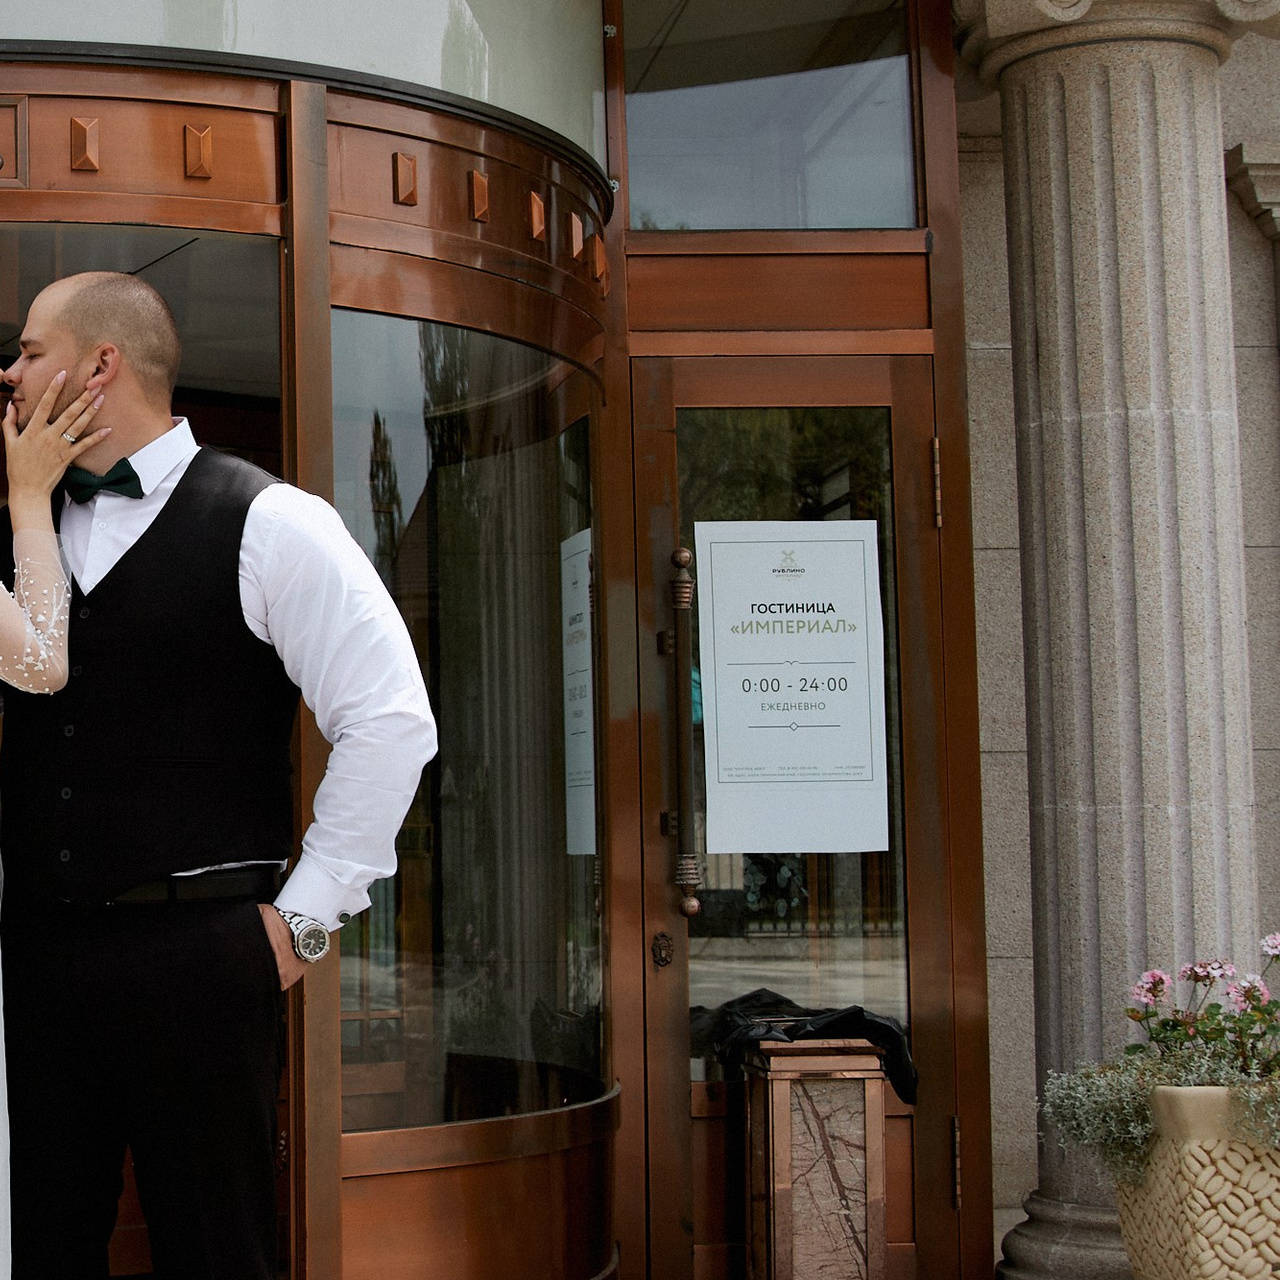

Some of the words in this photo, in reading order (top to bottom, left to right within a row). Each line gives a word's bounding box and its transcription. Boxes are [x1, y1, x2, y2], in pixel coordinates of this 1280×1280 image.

[750, 603, 836, 615] ГОСТИНИЦА
[730, 619, 857, 634] «ИМПЕРИАЛ»
[741, 678, 780, 693] 0:00
[799, 677, 848, 692] 24:00
[760, 702, 826, 712] ЕЖЕДНЕВНО
